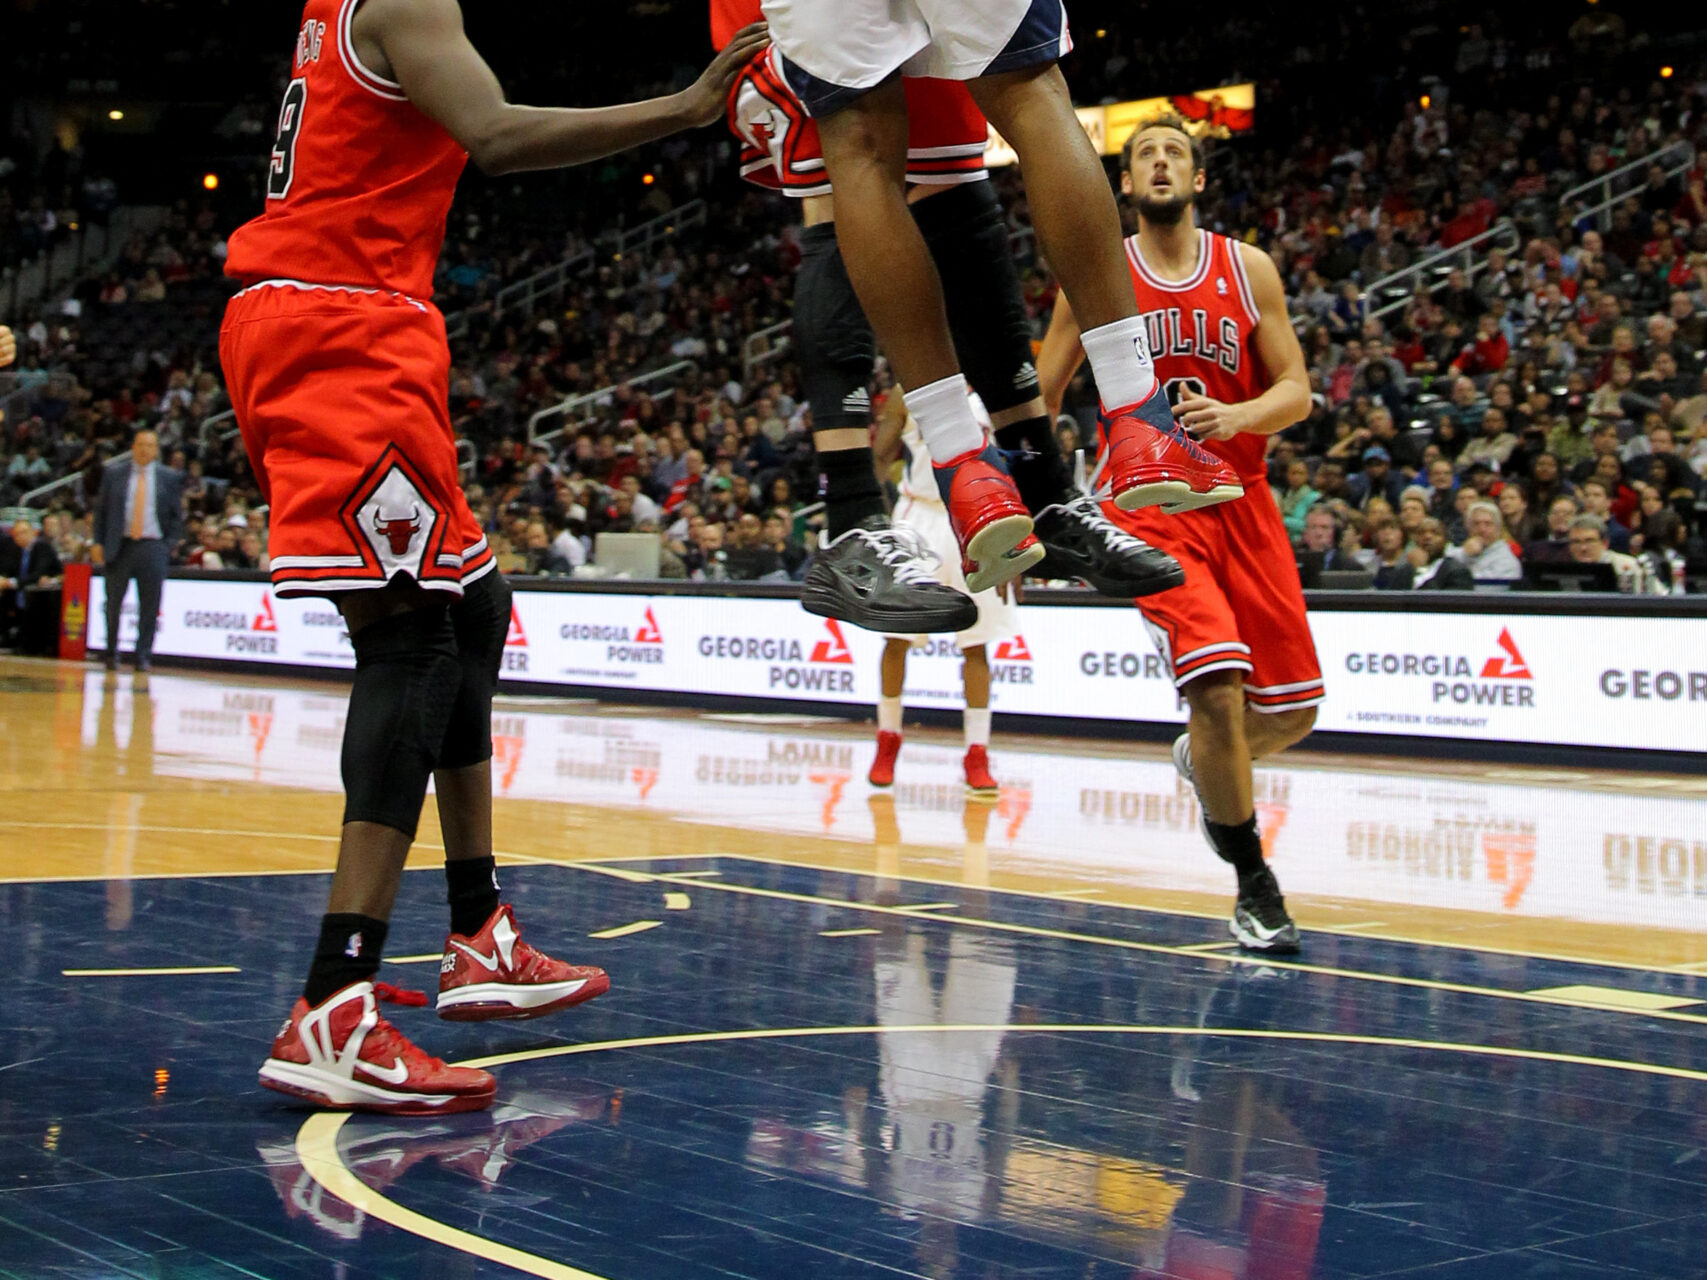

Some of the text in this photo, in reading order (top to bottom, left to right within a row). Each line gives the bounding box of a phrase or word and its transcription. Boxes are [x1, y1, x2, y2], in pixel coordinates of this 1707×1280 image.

[267, 77, 307, 199] 9
[184, 610, 247, 630] GEORGIA
[560, 623, 630, 642] GEORGIA
[226, 634, 278, 654] POWER
[607, 645, 664, 663] POWER
[698, 635, 804, 662] GEORGIA
[1345, 652, 1473, 677] GEORGIA
[769, 666, 855, 692] POWER
[1432, 682, 1535, 707] POWER
